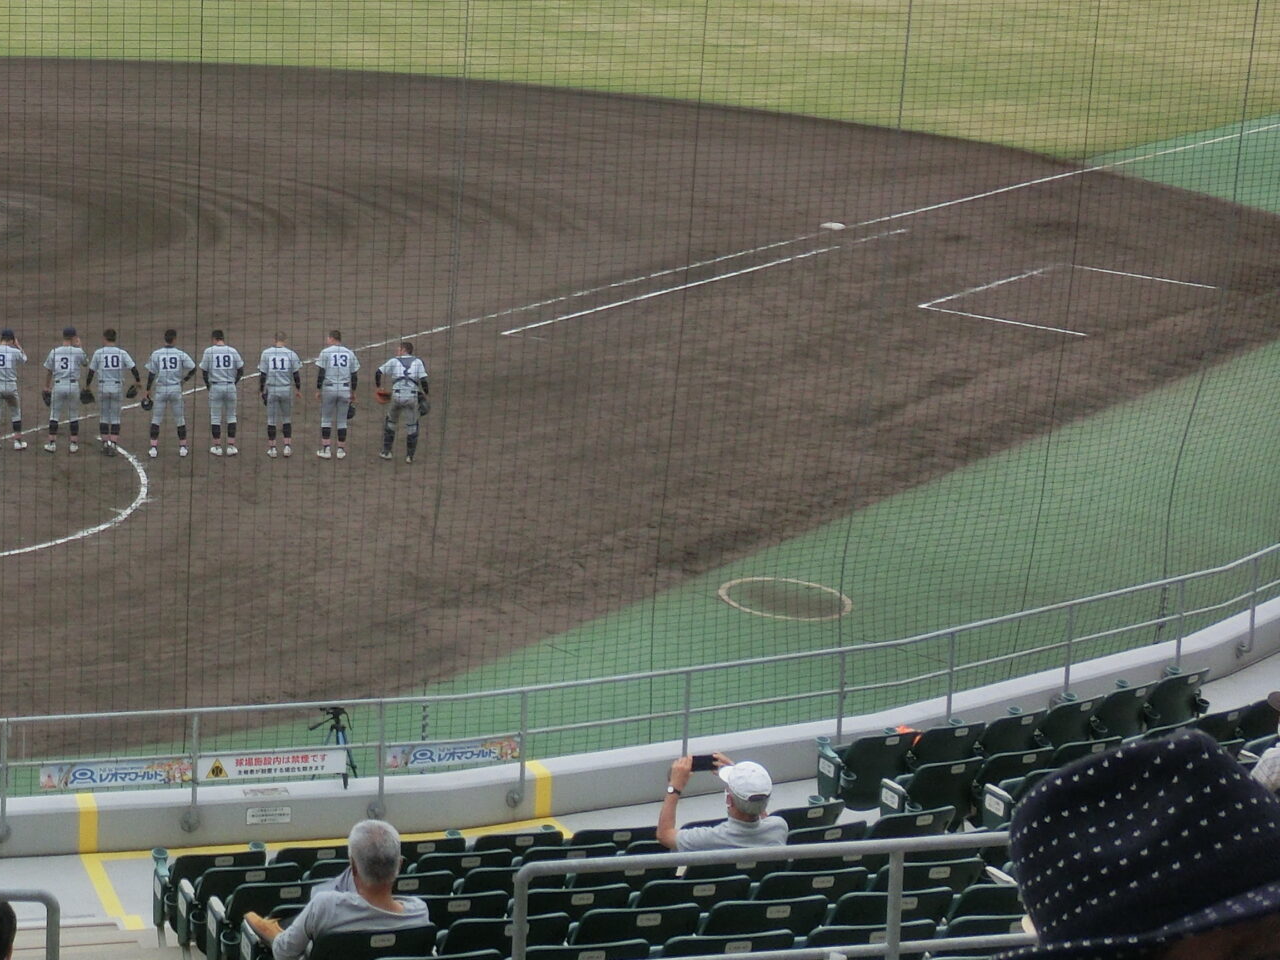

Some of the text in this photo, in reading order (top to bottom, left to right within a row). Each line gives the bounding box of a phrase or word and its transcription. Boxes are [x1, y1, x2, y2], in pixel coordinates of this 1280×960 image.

[60, 357, 69, 370] 3
[104, 355, 120, 368] 10
[162, 356, 178, 370] 19
[215, 355, 231, 368] 18
[271, 357, 286, 370] 11
[332, 354, 348, 368] 13
